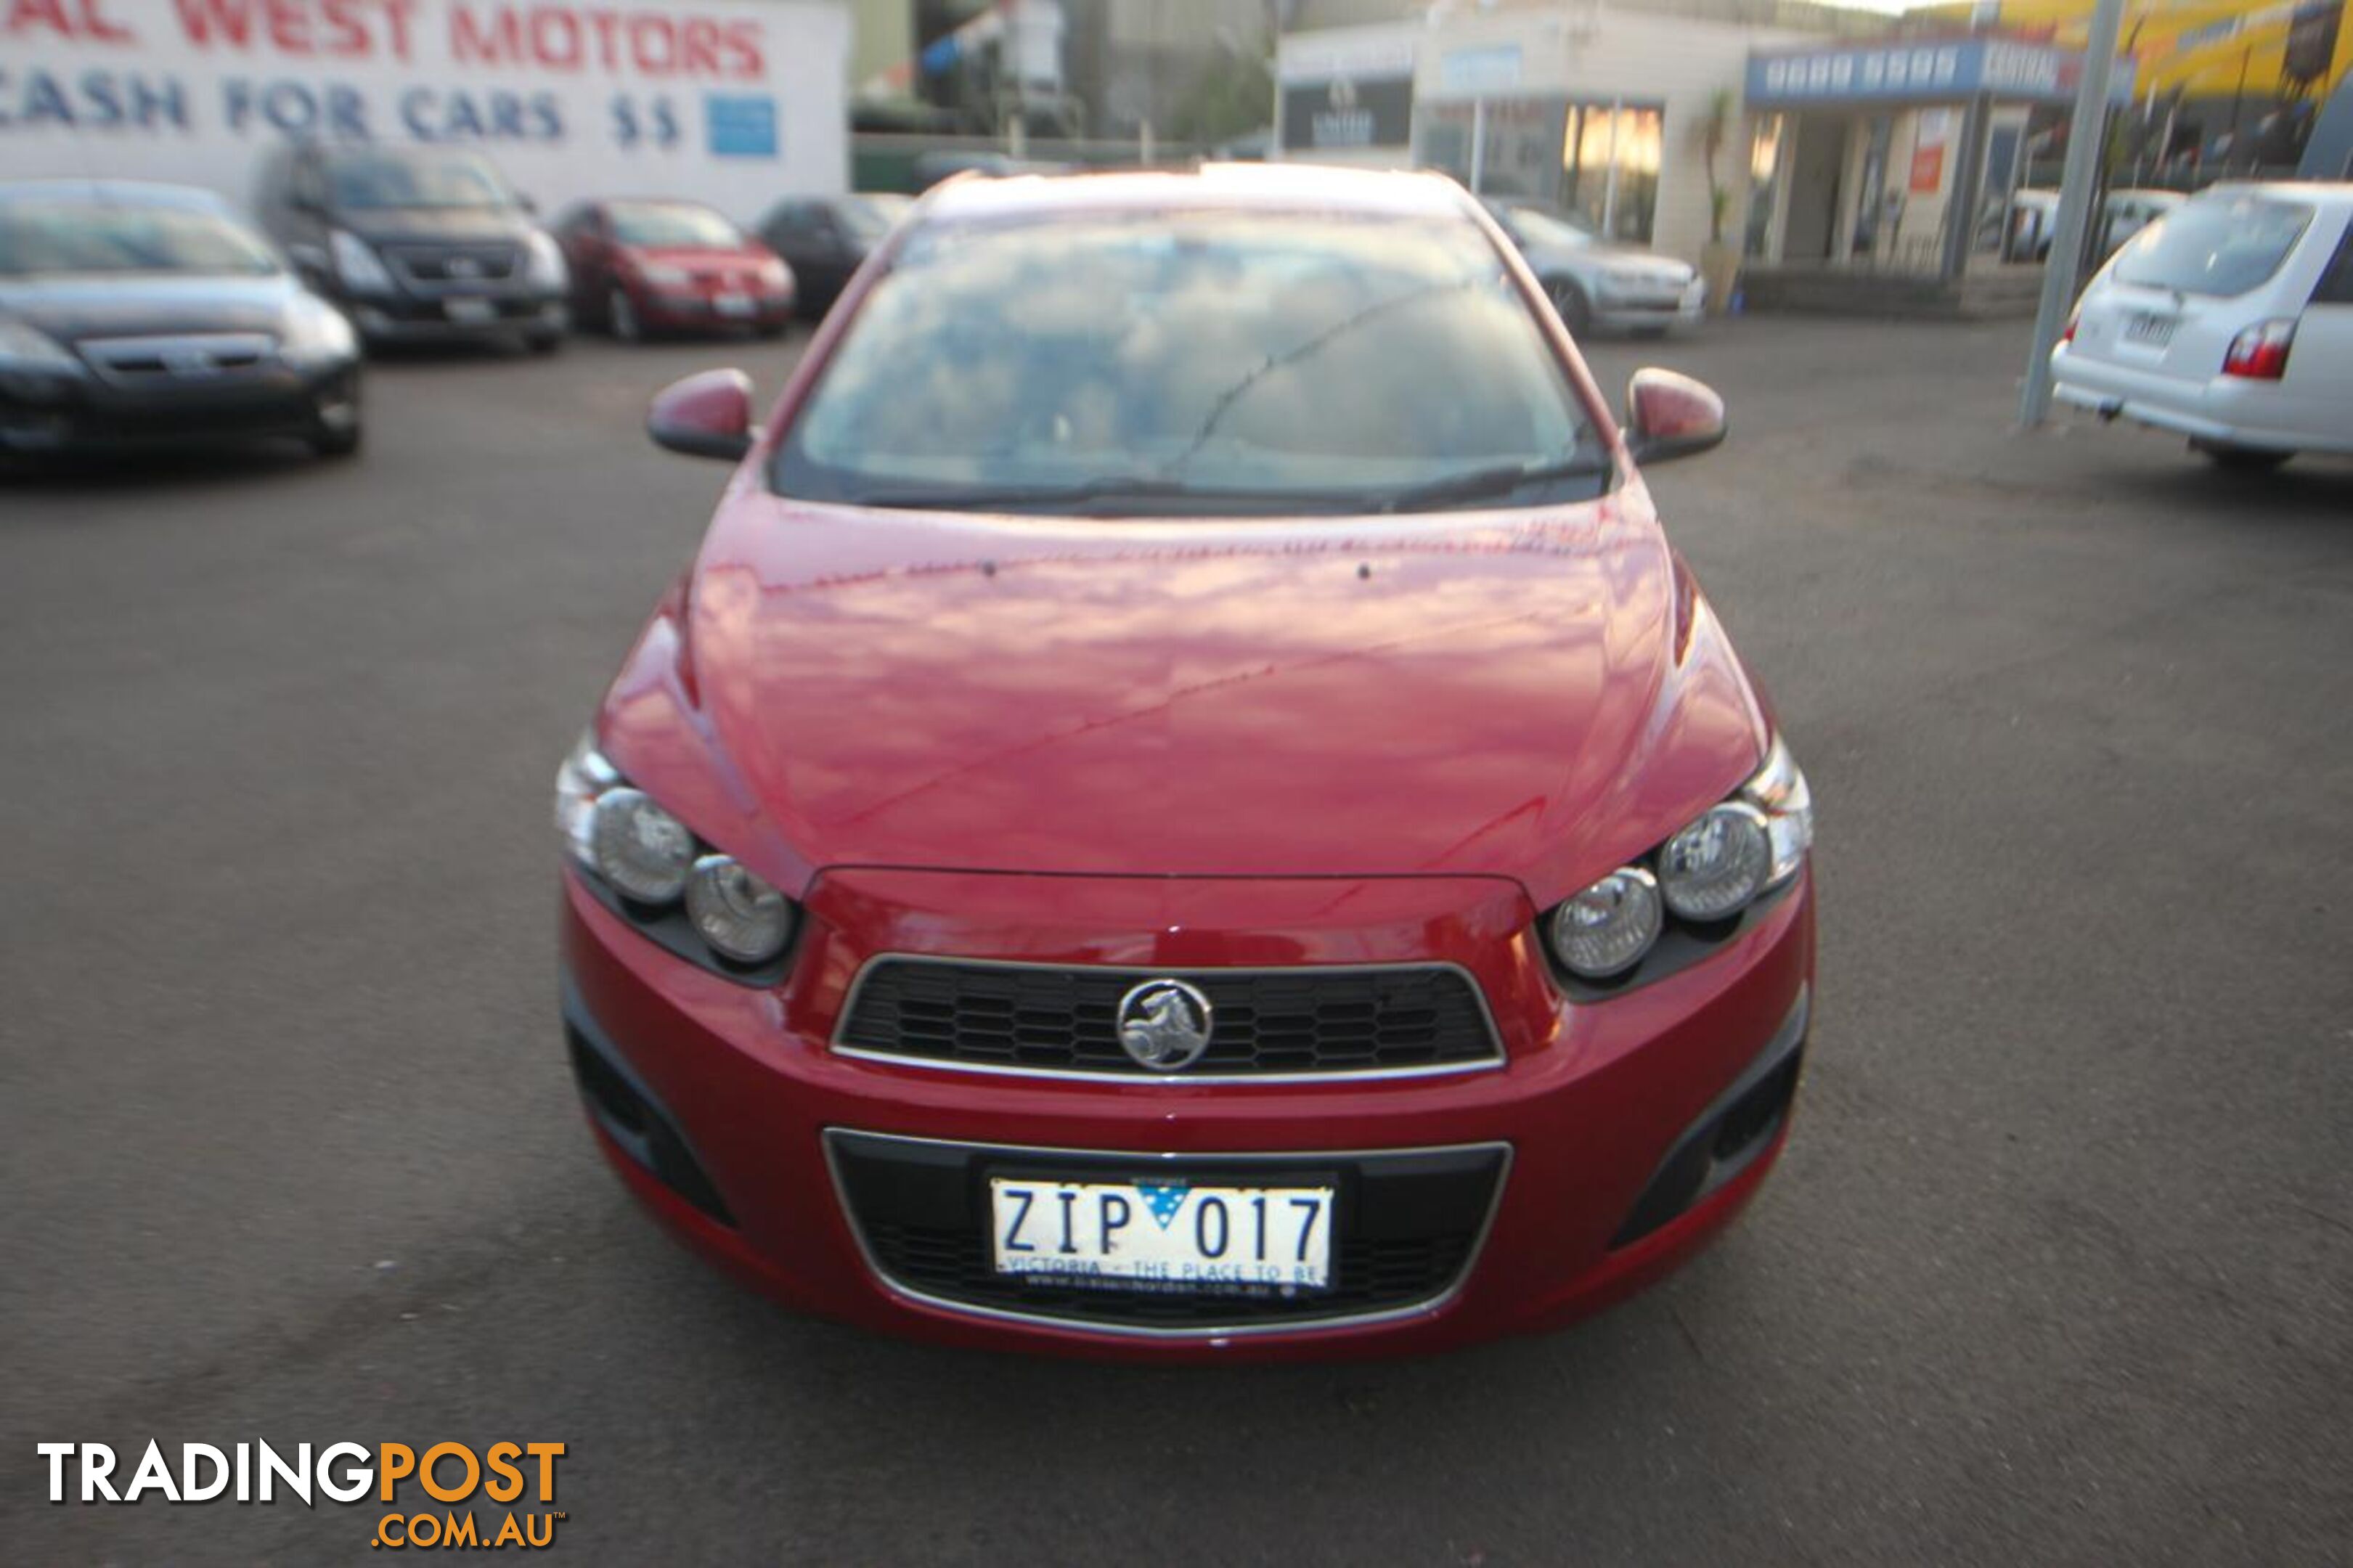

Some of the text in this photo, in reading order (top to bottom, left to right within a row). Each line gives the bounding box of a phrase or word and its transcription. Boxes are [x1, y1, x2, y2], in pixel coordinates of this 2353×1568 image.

[168, 0, 414, 61] WEST
[446, 3, 768, 78] MOTORS
[0, 69, 189, 129] ASH
[222, 75, 369, 141] FOR
[399, 86, 566, 142] CARS
[1003, 1189, 1321, 1262] ZIP 017
[1008, 1257, 1101, 1275] VICTORIA
[1133, 1260, 1169, 1278] THE
[1182, 1265, 1244, 1282] PLACE
[1255, 1266, 1281, 1283] TO
[1294, 1267, 1317, 1283] BE
